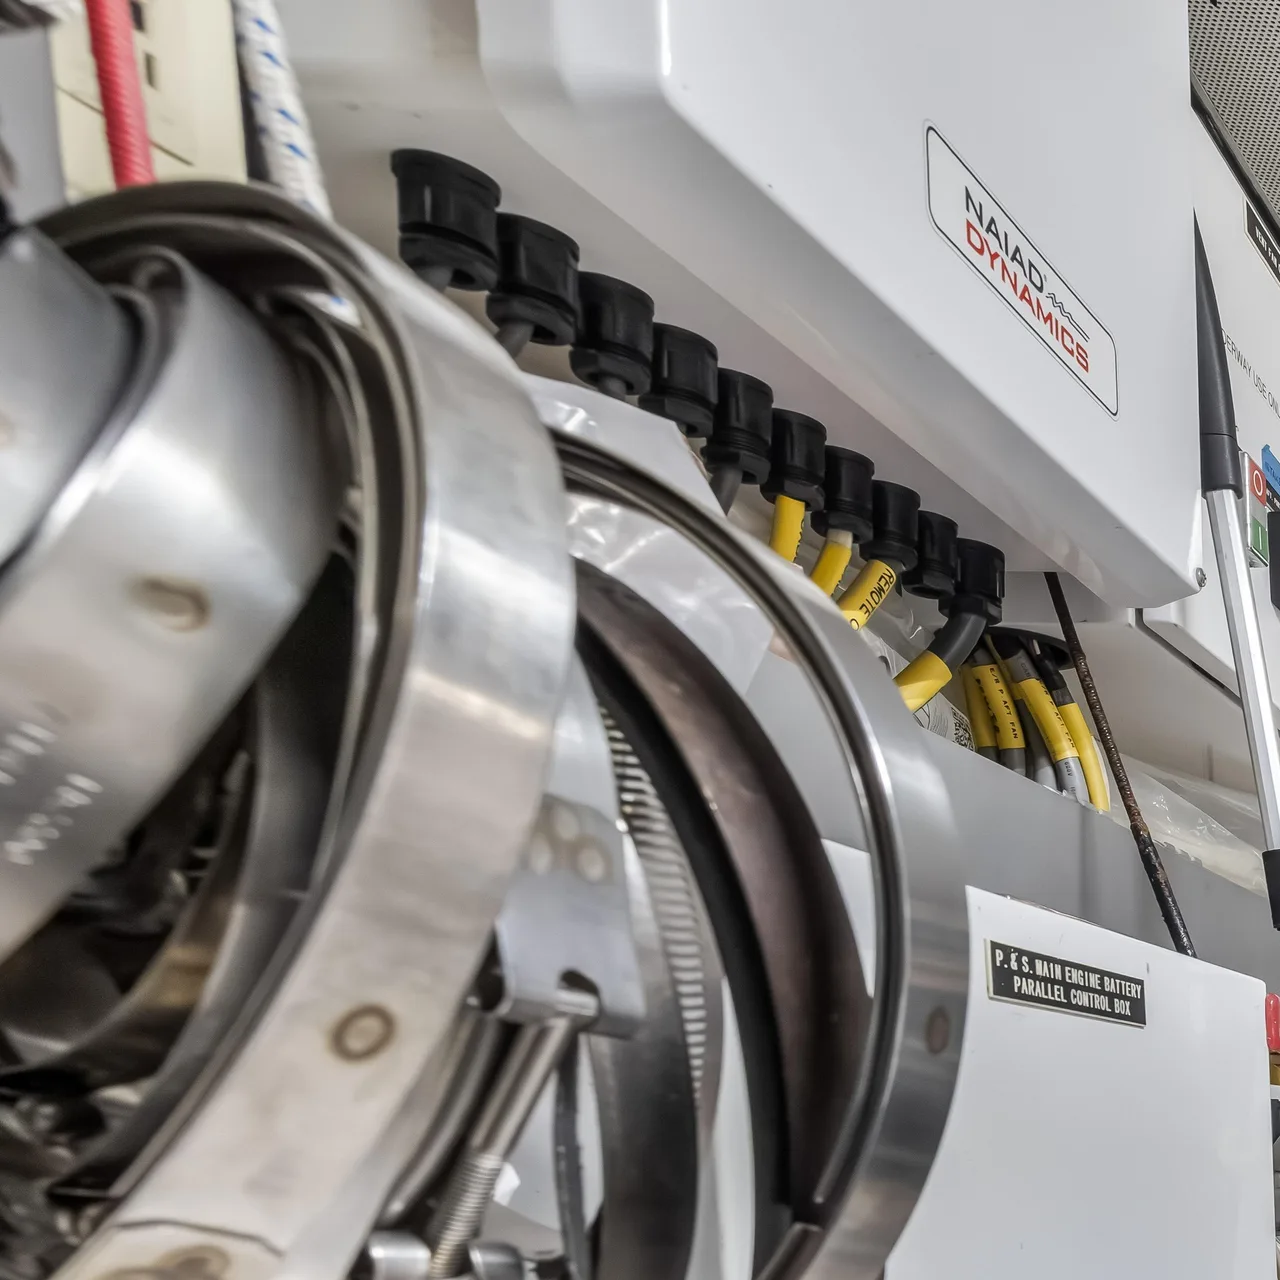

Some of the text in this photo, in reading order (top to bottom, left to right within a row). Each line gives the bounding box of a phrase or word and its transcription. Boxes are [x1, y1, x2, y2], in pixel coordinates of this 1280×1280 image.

[965, 185, 1044, 293] NAIAD
[1255, 226, 1268, 252] VENT
[1268, 247, 1278, 268] FAN
[965, 218, 1090, 373] DYNAMICS
[1252, 369, 1268, 400] USE
[859, 567, 895, 619] REMOTE
[1009, 721, 1019, 740] FAN
[995, 949, 1142, 999] P. & S. MAIN ENGINE BATTERY
[1013, 975, 1131, 1016] PARALLEL CONTROL BOX
